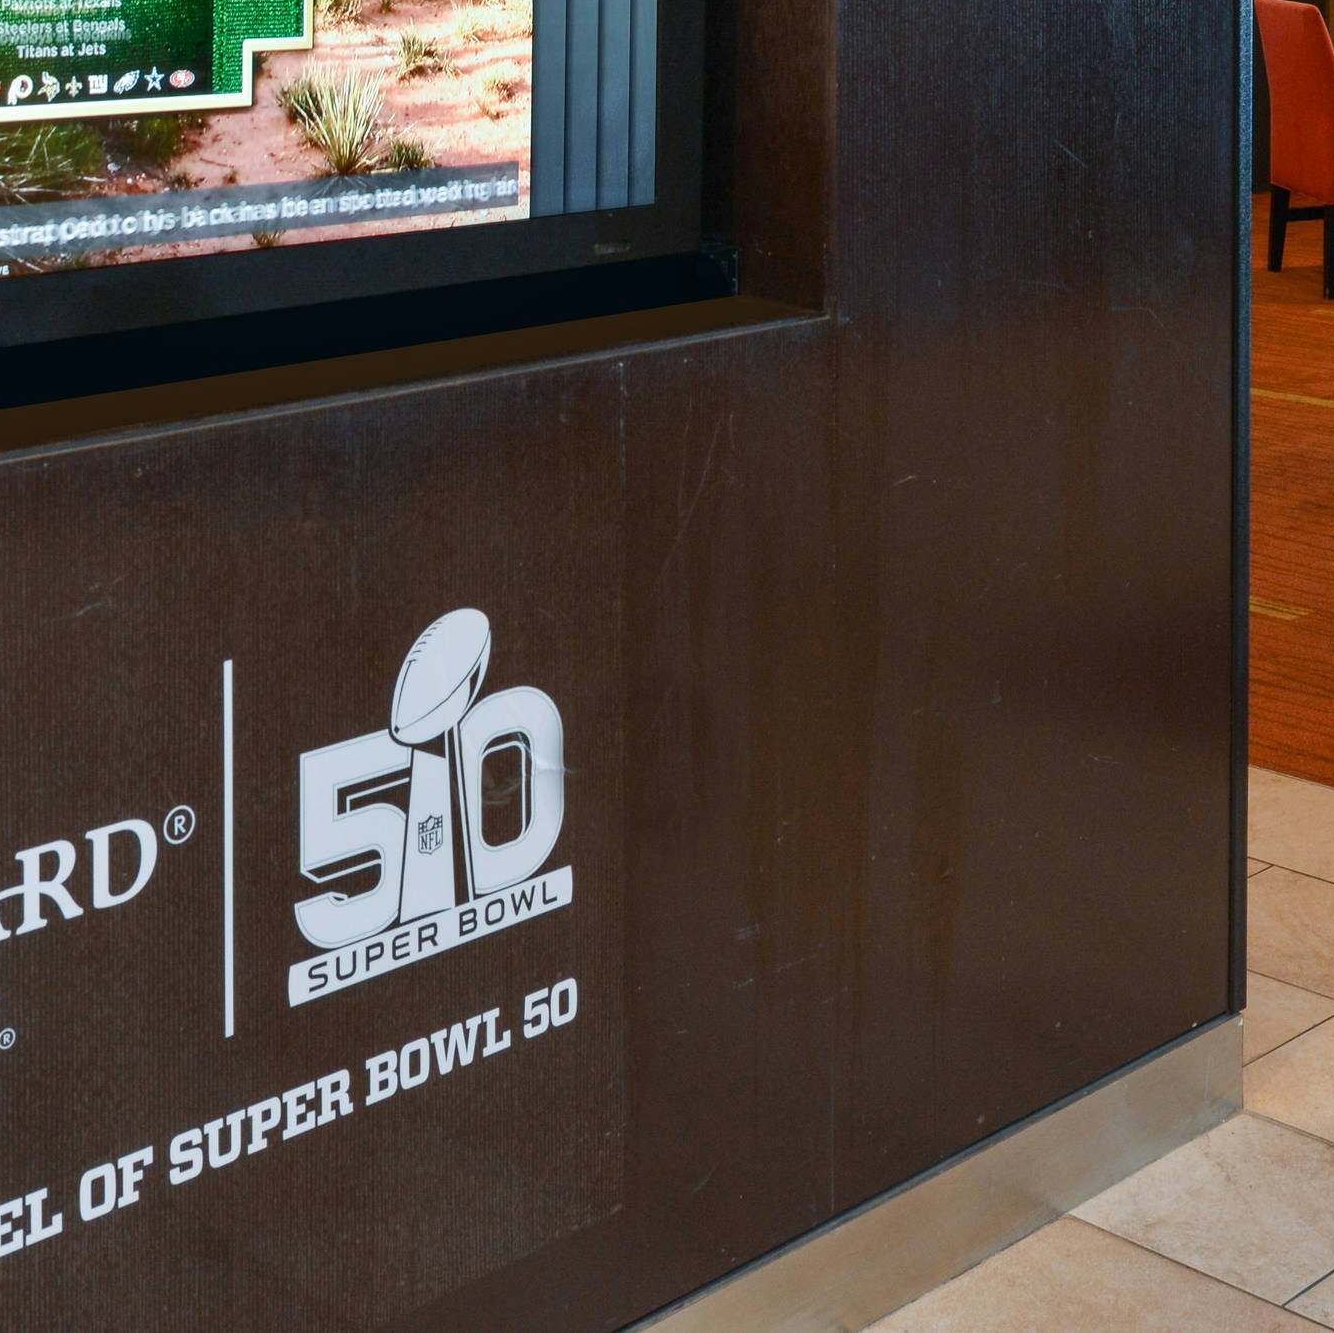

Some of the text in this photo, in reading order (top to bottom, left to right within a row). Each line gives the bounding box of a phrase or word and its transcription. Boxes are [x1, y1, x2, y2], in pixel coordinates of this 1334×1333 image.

[55, 21, 69, 34] at
[73, 18, 126, 34] Bengals
[17, 42, 106, 58] Titans at Jets
[420, 829, 442, 851] NFL
[308, 880, 559, 993] SUPER BOWL
[79, 1146, 153, 1222] OF
[169, 1069, 354, 1186] SUPER
[366, 1007, 511, 1106] BOWL
[523, 977, 578, 1039] 50
